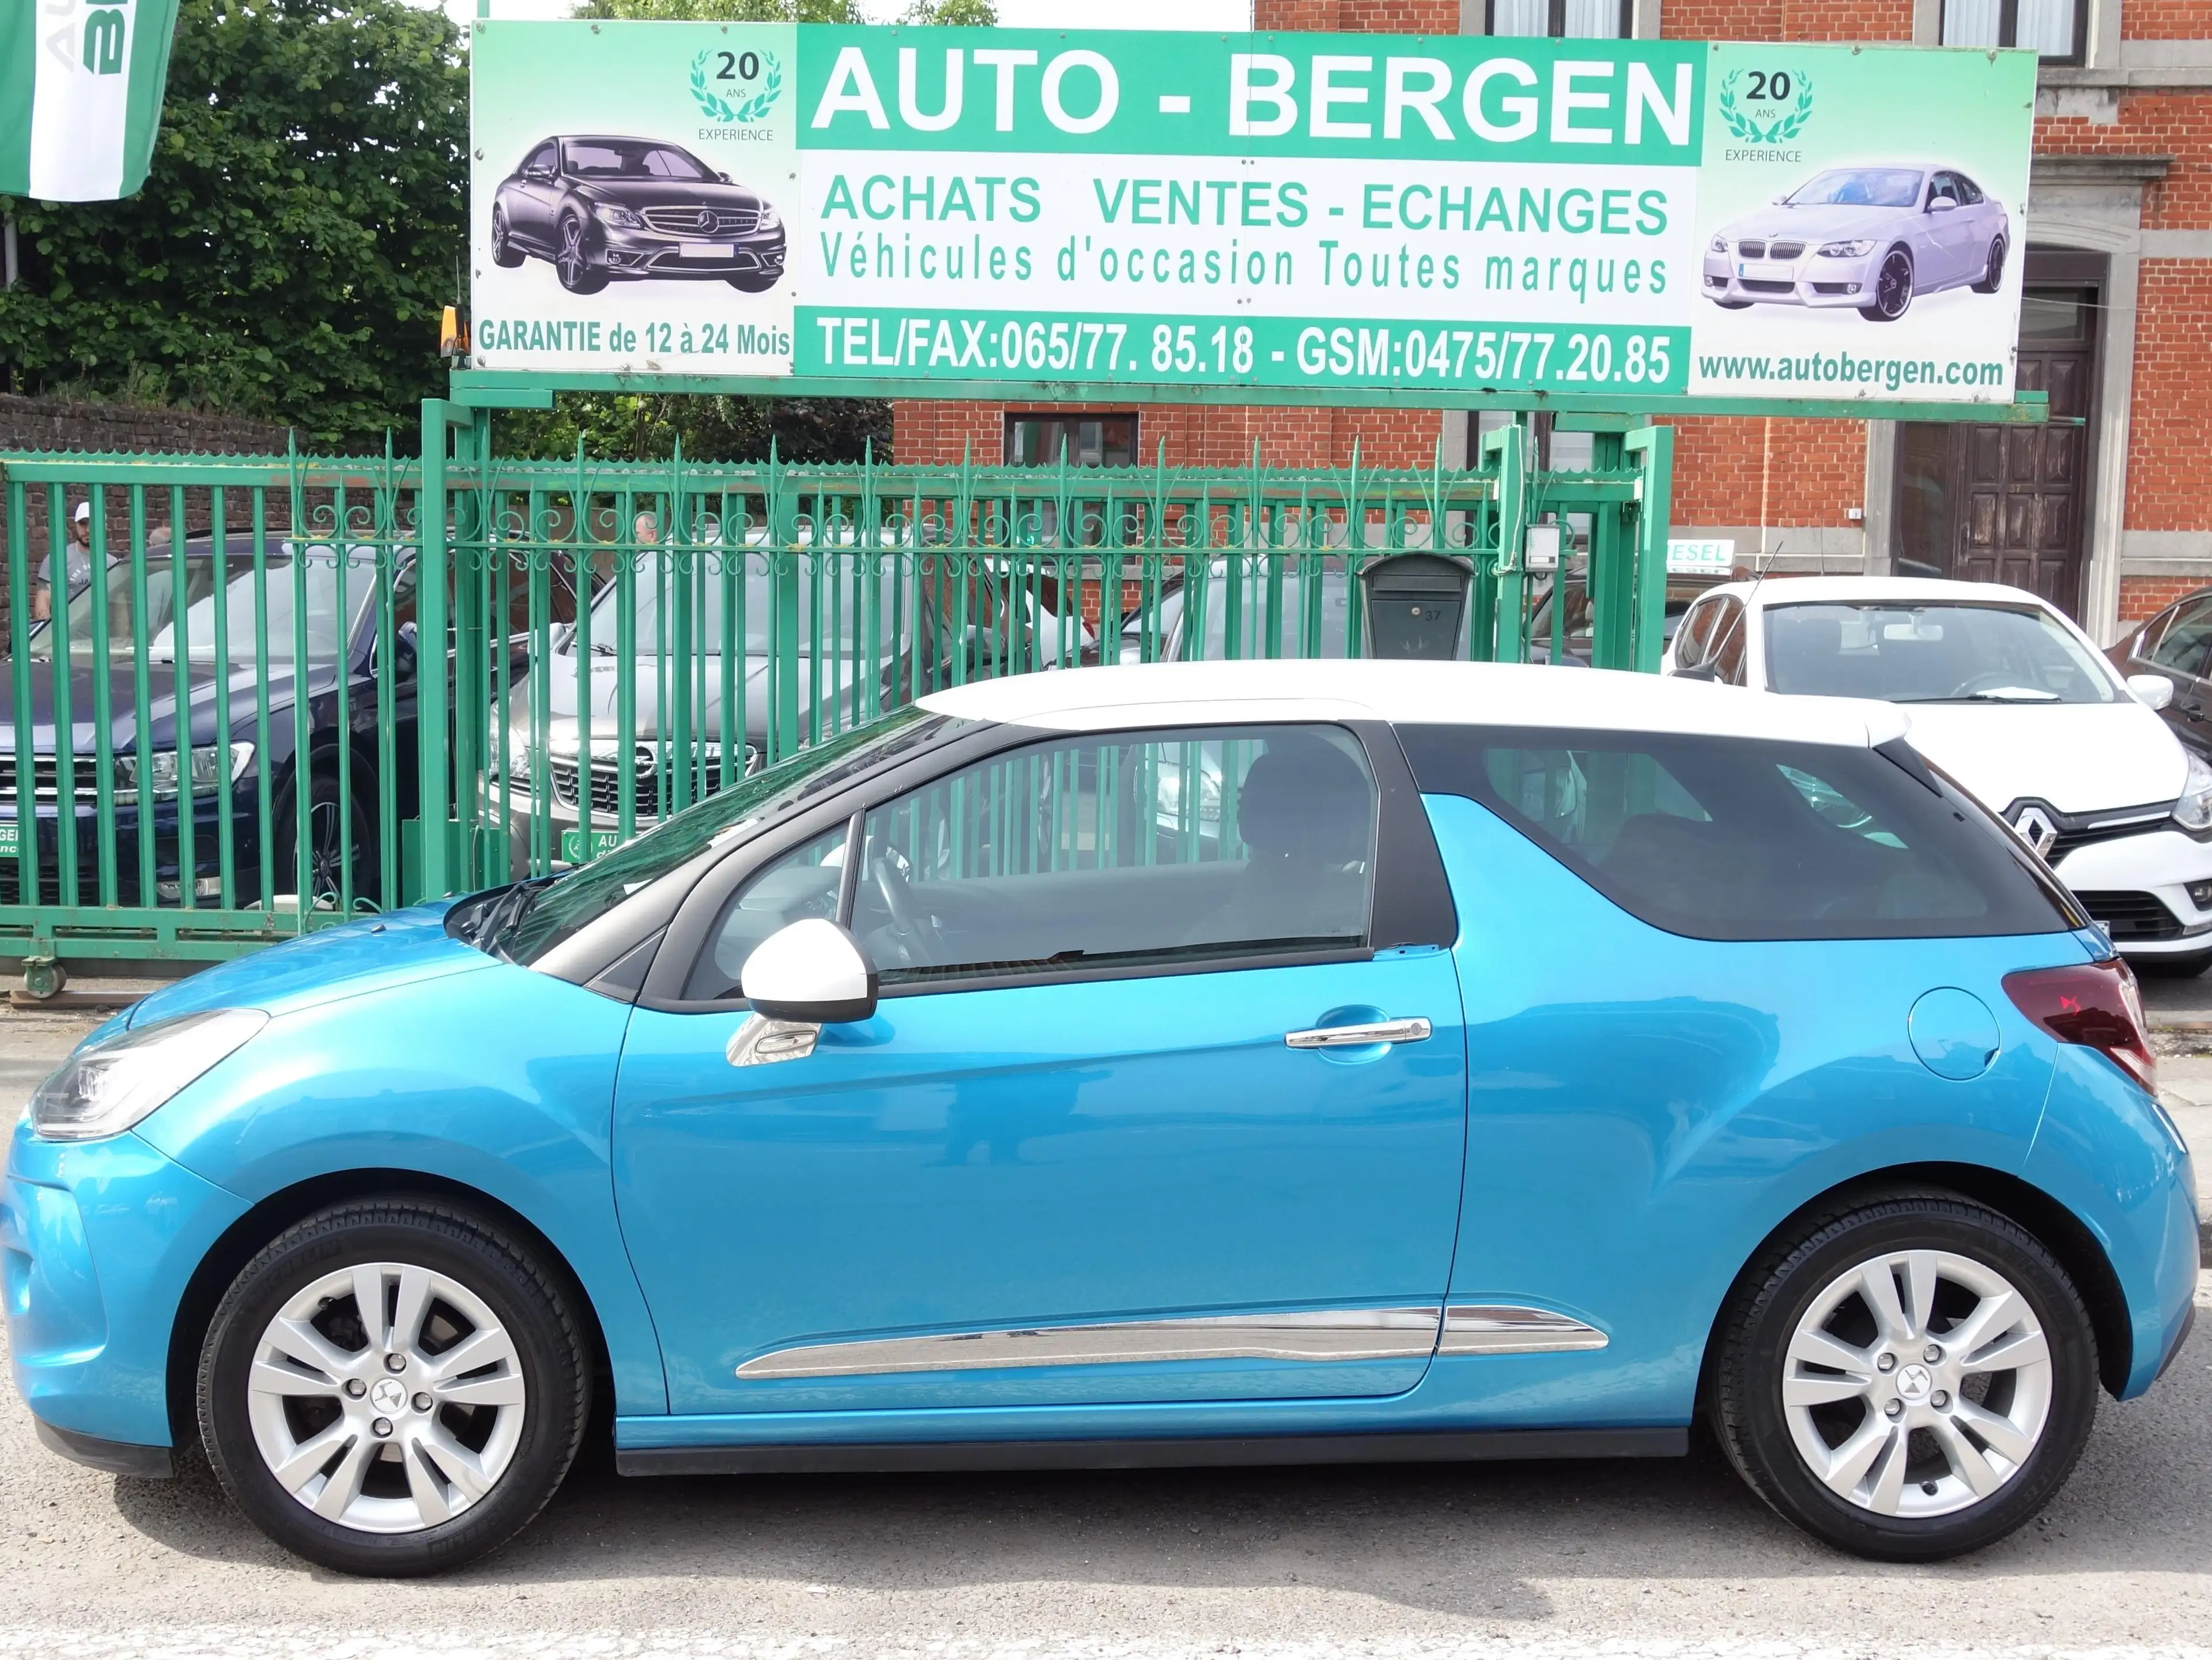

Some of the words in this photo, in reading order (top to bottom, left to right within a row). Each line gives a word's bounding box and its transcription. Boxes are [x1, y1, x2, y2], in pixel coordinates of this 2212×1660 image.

[83, 0, 128, 75] B
[716, 51, 759, 80] 20
[726, 88, 746, 98] ANS
[810, 46, 1120, 134] AUTO
[1228, 52, 1693, 146] BERGEN
[1746, 71, 1791, 100] 20
[1755, 108, 1776, 118] ANS
[698, 128, 773, 141] EXPERIENCE
[1725, 149, 1802, 163] EXPERIENCE
[821, 174, 1041, 223] ACHATS
[1093, 178, 1308, 228] VENTES
[1362, 183, 1668, 236] ECHANGES
[820, 232, 1032, 281] Véhicules
[1057, 235, 1293, 286] d'occasion
[1318, 240, 1460, 289] Toutes
[1485, 255, 1666, 304] marques
[478, 319, 601, 351] GARANTIE
[609, 322, 636, 353] de
[646, 322, 672, 353] 12
[680, 322, 691, 353] à
[701, 323, 729, 353] 24
[737, 325, 790, 356] Mois
[1296, 326, 1671, 384] GSM:0475/77.20.85
[1699, 351, 2003, 391] www.autobergen.com
[1425, 609, 1441, 621] 37
